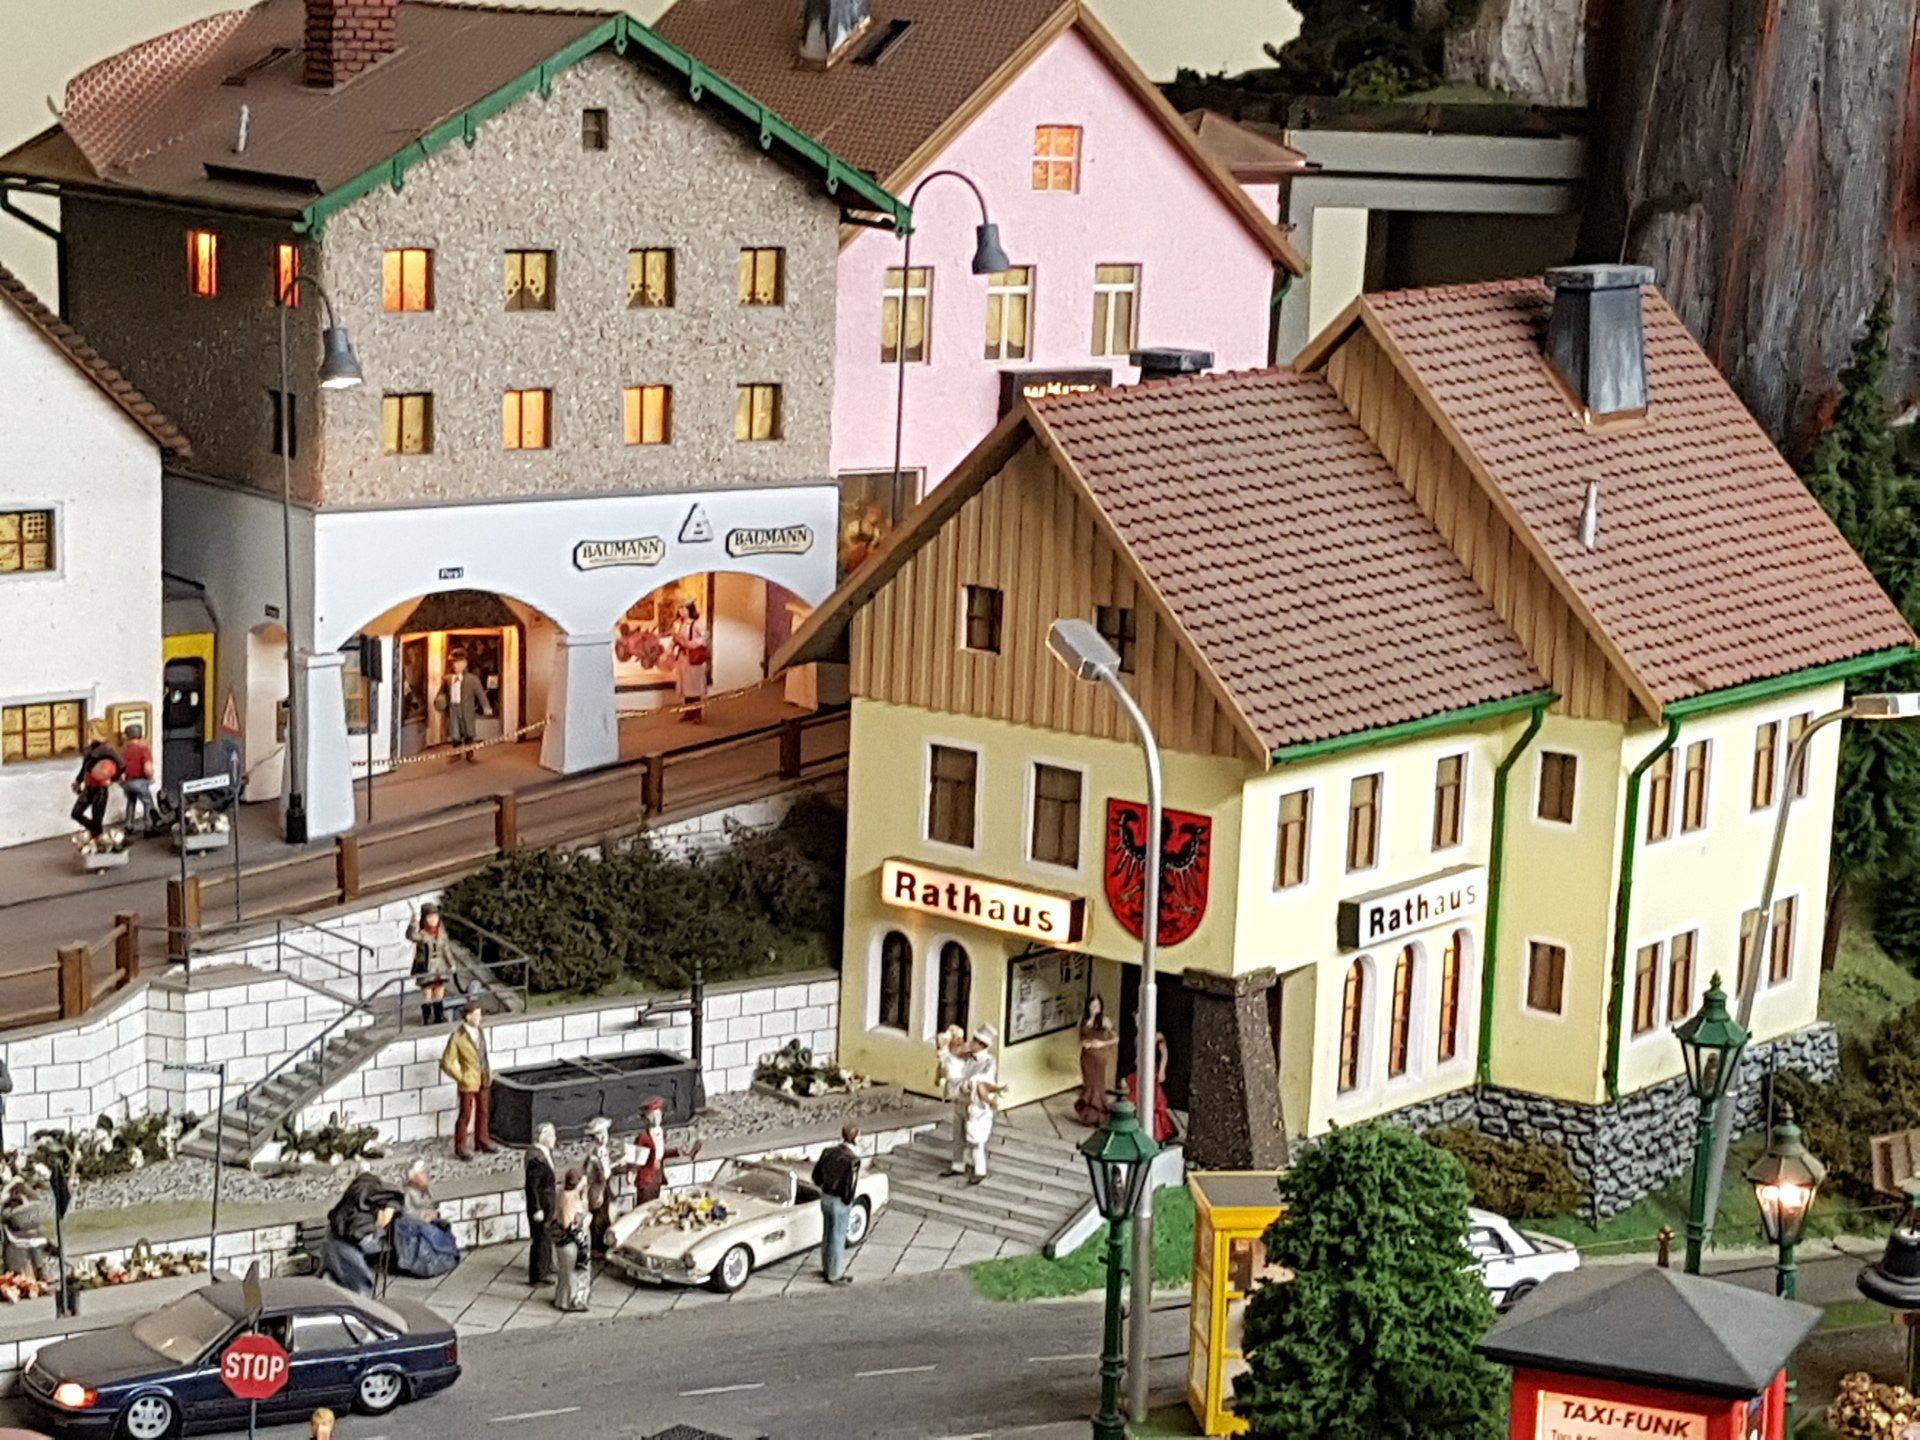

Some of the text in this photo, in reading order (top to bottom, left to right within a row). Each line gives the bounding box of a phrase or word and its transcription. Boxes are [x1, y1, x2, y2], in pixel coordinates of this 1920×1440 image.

[583, 540, 658, 558] BAUMANN
[735, 528, 806, 545] BAUMANN
[895, 870, 1054, 932] Rathaus
[1370, 885, 1476, 938] Rathaus
[225, 1351, 284, 1382] STOP
[1562, 1400, 1691, 1438] TAXI-FUNK
